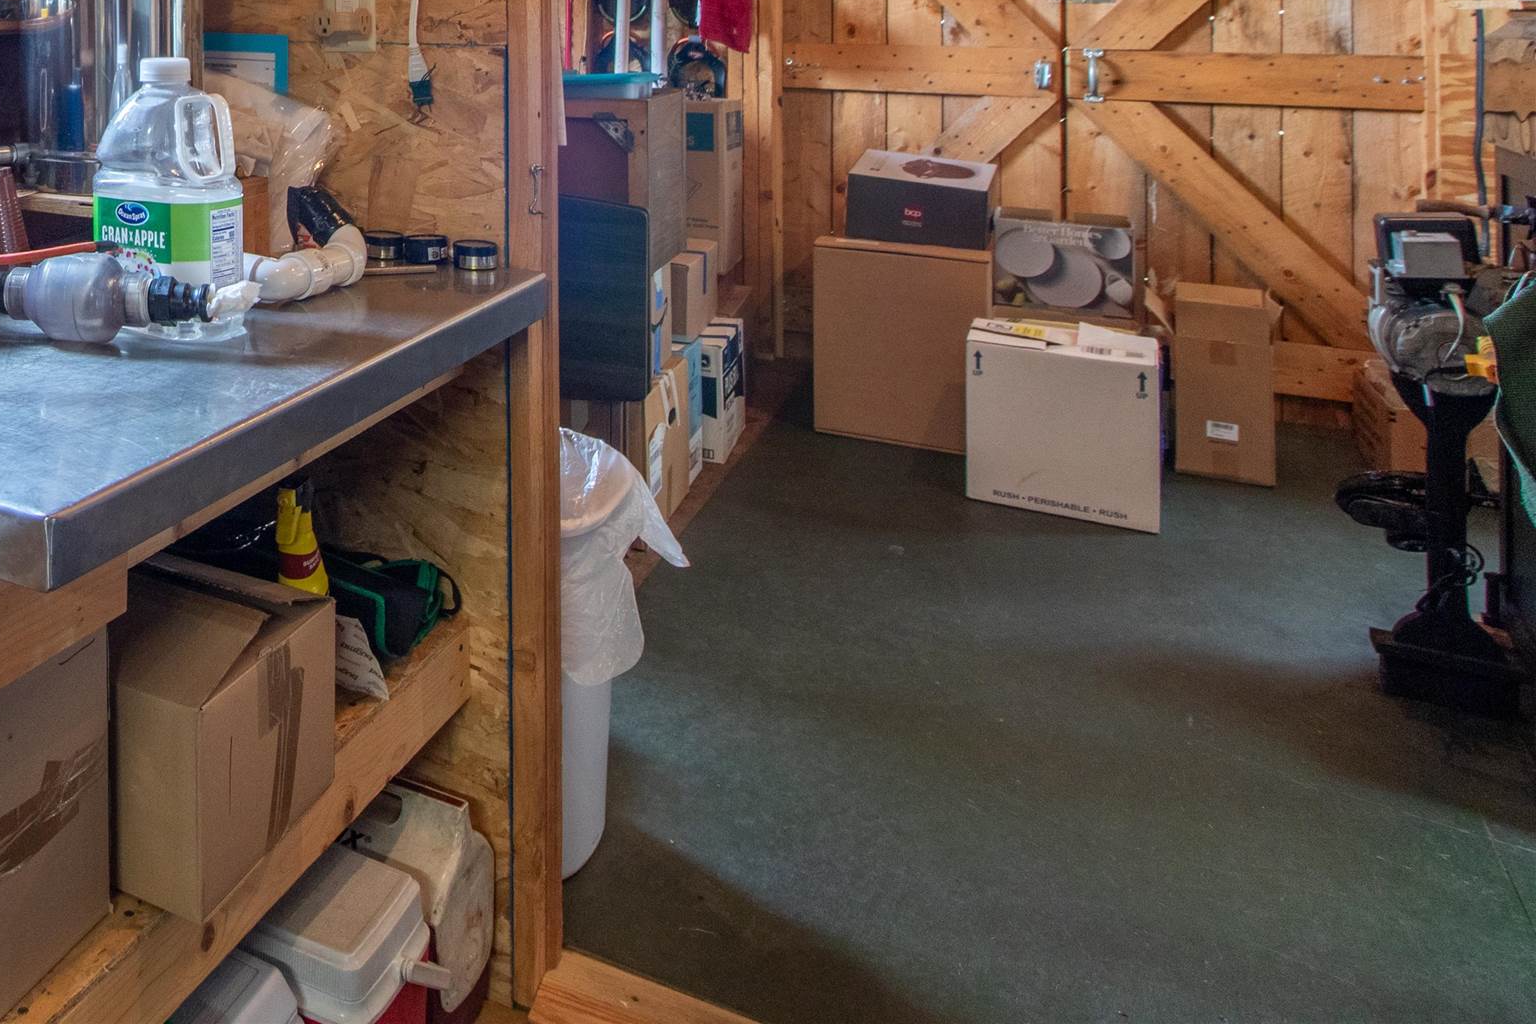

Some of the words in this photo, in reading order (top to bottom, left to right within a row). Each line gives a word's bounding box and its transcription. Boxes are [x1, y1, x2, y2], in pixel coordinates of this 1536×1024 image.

[992, 489, 1020, 500] RUSH
[1027, 495, 1090, 514] PERISHABLE
[1098, 508, 1128, 520] RUSH
